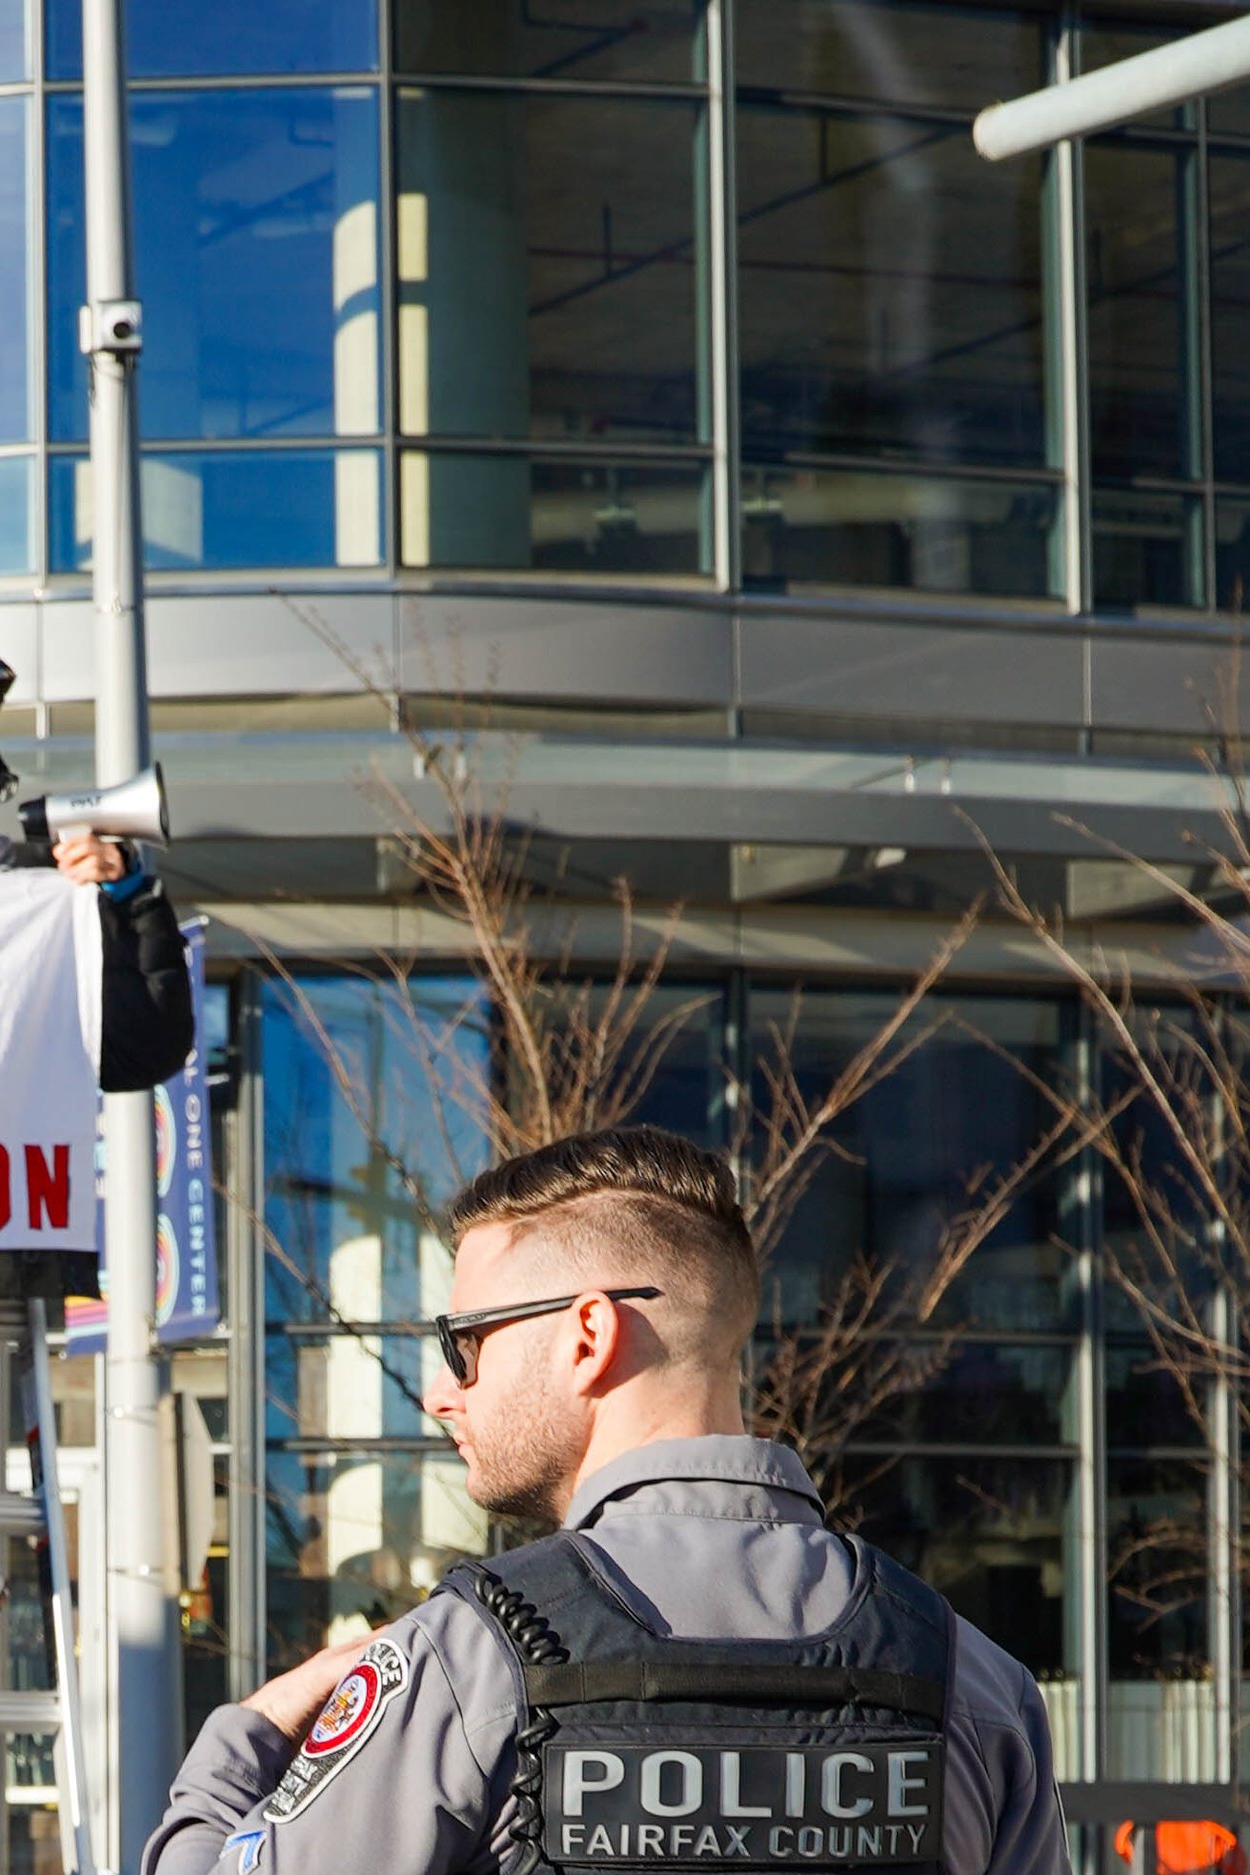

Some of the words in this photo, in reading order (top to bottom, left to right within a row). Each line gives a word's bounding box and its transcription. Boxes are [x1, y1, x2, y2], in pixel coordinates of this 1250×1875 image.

[185, 1094, 204, 1170] ONE
[188, 1178, 207, 1317] CENTER
[562, 1750, 929, 1818] POLICE
[561, 1823, 750, 1857] FAIRFAX
[768, 1823, 926, 1858] COUNTY
